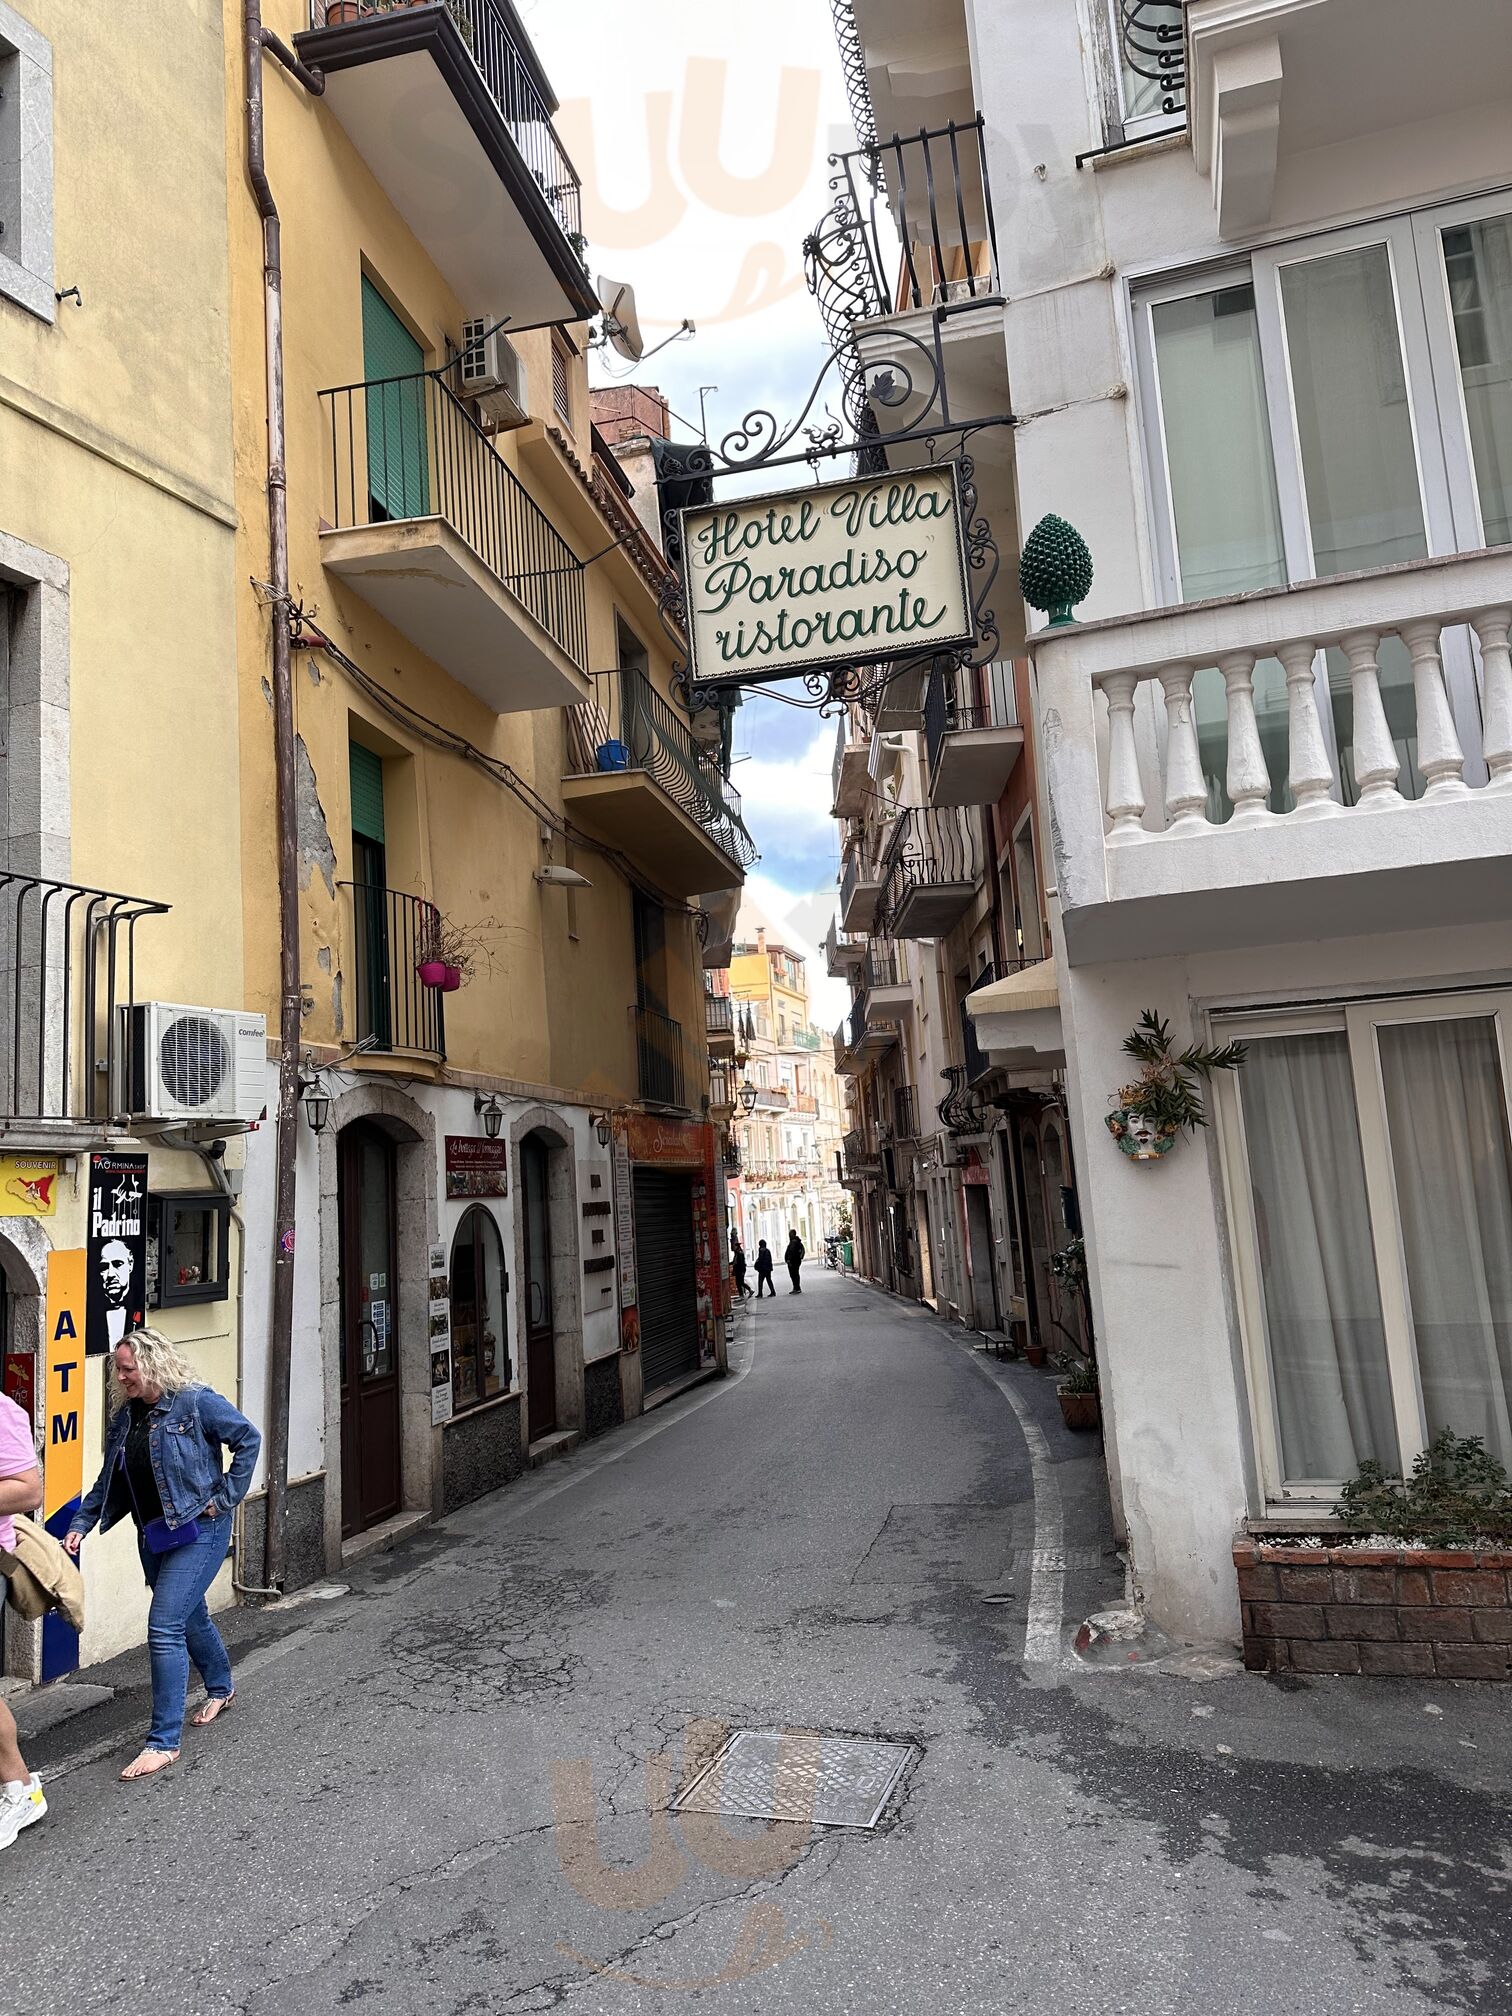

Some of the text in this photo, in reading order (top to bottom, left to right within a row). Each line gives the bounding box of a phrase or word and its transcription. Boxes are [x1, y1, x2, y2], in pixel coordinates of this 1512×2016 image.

[697, 500, 821, 564] Hotel
[715, 588, 947, 662] ristorante
[15, 1160, 57, 1169] SOUVENIR
[93, 1186, 103, 1210] il
[92, 1211, 141, 1238] Padrino
[53, 1310, 78, 1446] ATM
